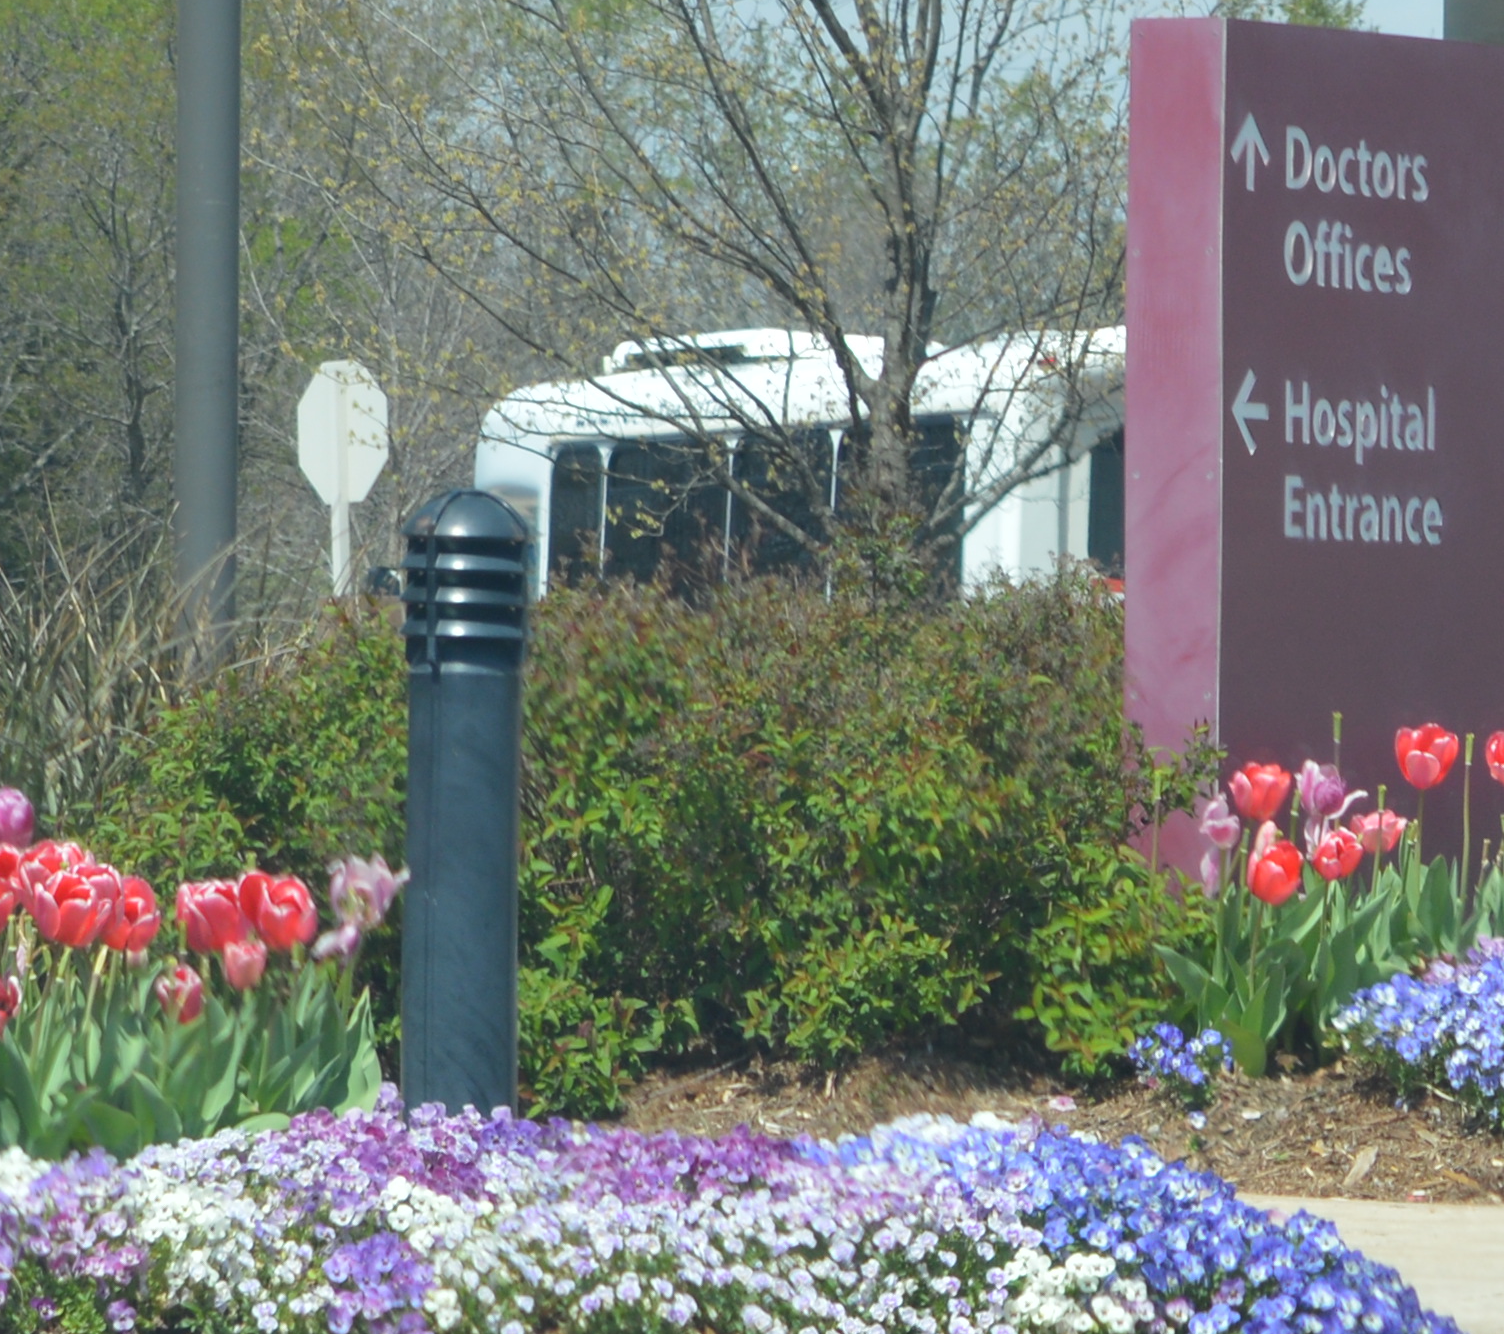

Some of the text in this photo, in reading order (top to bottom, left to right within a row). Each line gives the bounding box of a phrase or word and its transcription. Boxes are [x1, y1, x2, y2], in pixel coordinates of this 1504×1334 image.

[1284, 125, 1429, 203] Doctors
[1283, 220, 1412, 295] Offices
[1284, 379, 1436, 465] Hospital
[1283, 475, 1443, 546] Entrance
